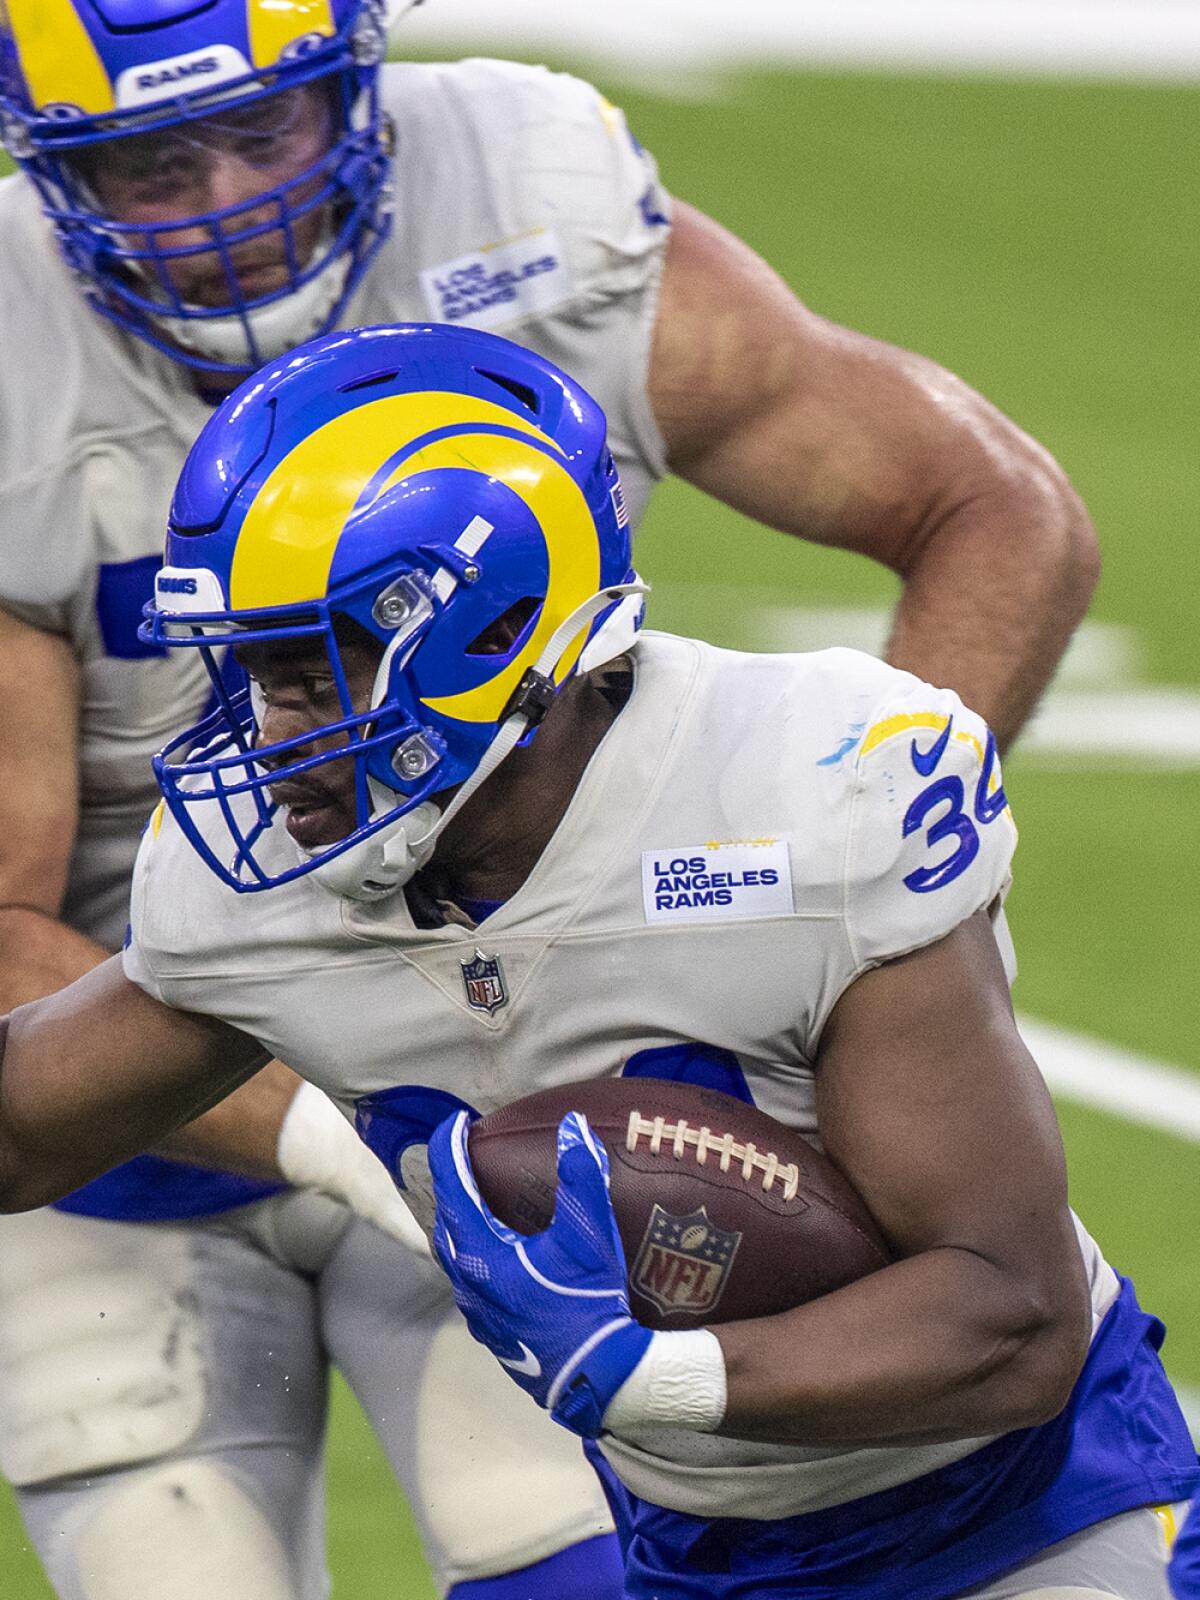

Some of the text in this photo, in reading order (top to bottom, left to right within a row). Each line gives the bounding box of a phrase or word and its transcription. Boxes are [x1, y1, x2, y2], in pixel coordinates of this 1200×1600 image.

[137, 56, 219, 91] RAMS
[654, 856, 707, 877] LOS
[654, 869, 779, 894] ANGELES
[656, 889, 734, 911] RAMS
[640, 1246, 714, 1304] NFL
